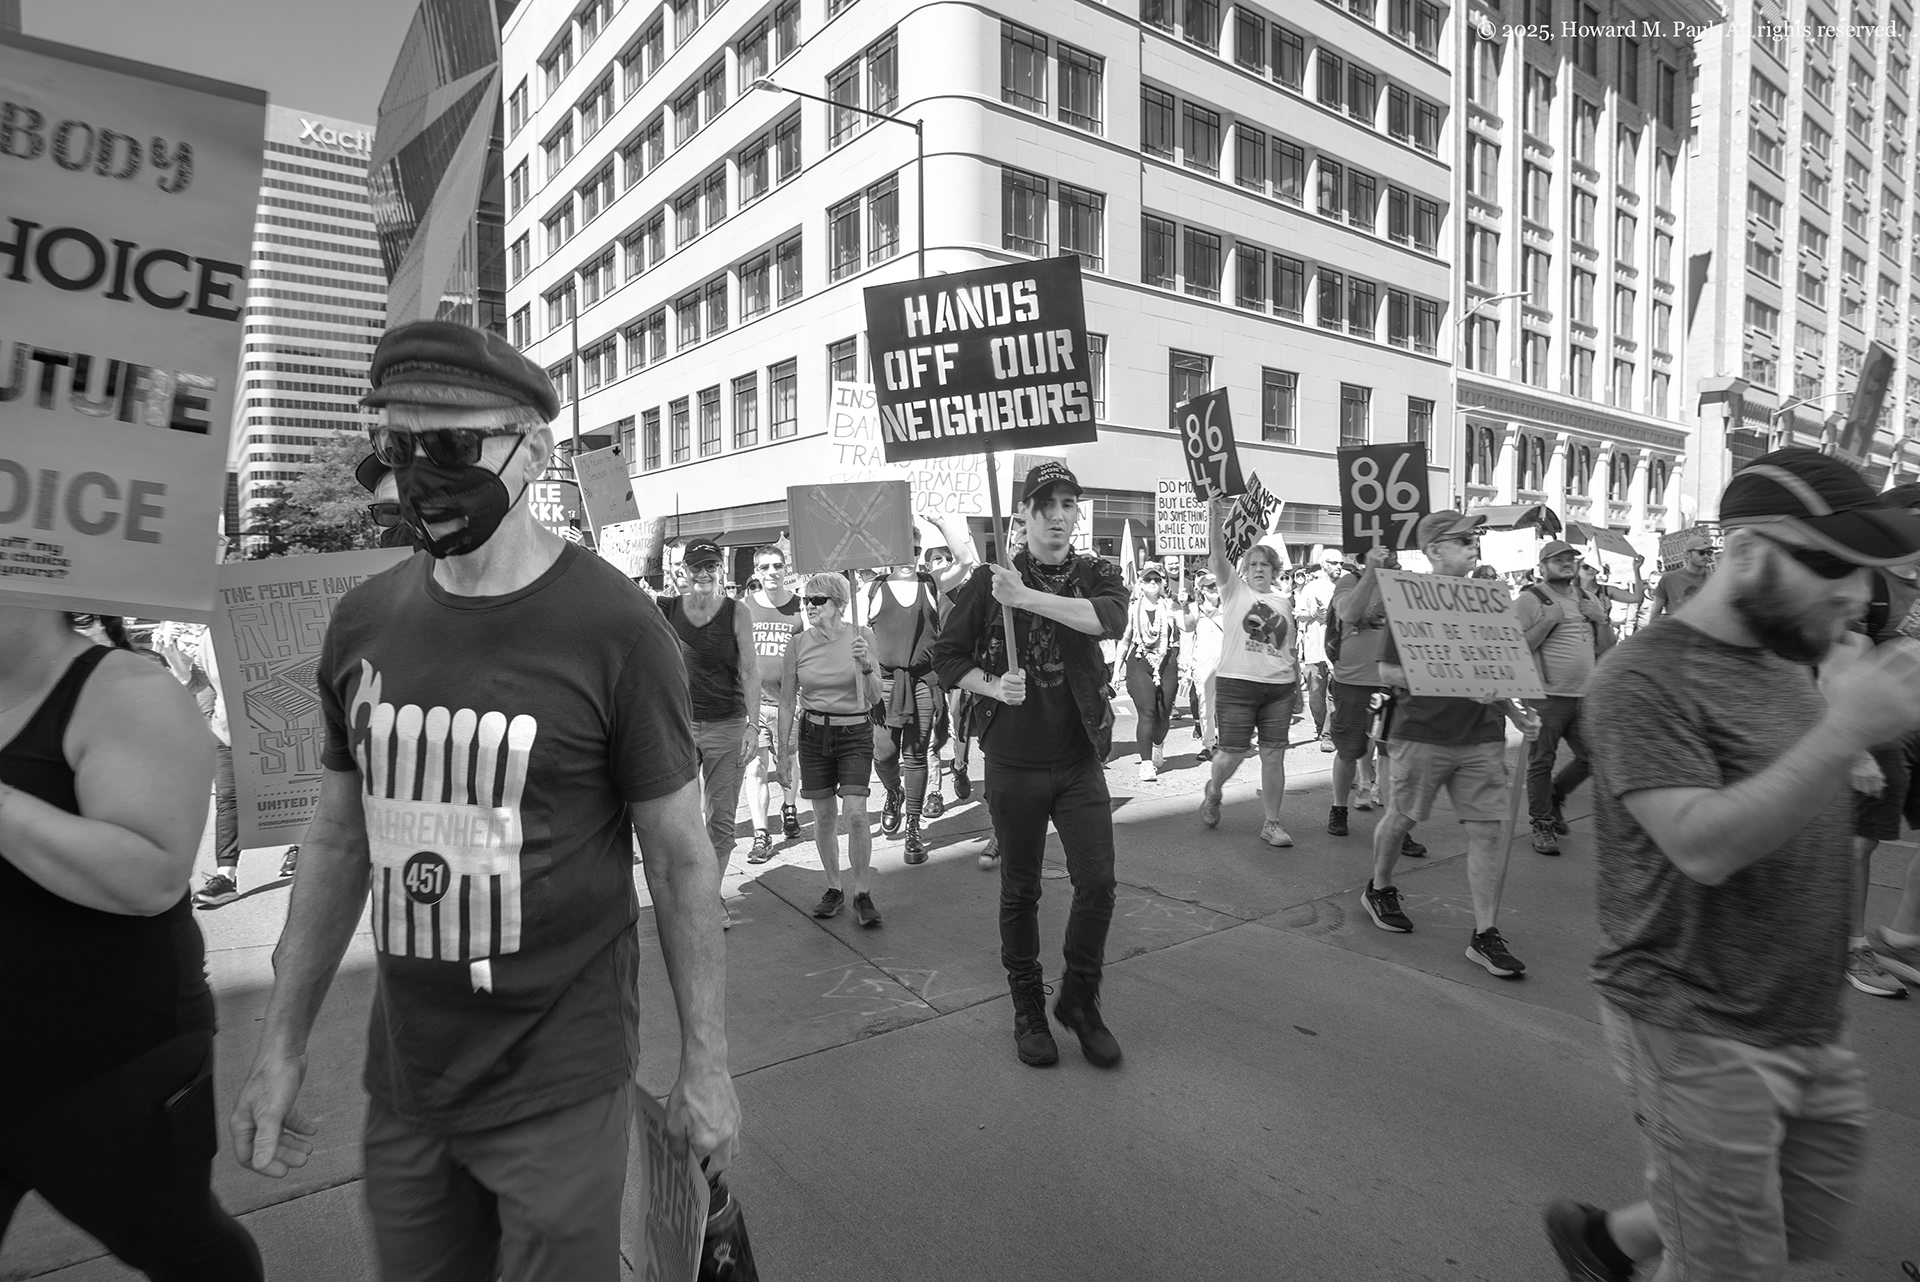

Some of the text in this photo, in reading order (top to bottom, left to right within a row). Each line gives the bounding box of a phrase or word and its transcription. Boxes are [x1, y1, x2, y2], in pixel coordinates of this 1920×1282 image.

[299, 118, 376, 153] Xactl
[904, 279, 1040, 338] HANDS
[883, 329, 1075, 391] OFF OUR
[836, 387, 876, 409] INS
[881, 381, 1092, 443] NEIGHBORS
[1185, 399, 1224, 459] 86
[907, 471, 981, 492] ARMED
[1037, 473, 1071, 482] MATTER
[1190, 451, 1228, 496] 47
[1350, 452, 1420, 512] 86
[529, 483, 561, 503] ICE
[1159, 481, 1194, 493] DO MO
[1159, 497, 1177, 509] BUY
[1260, 488, 1282, 513] NOT
[528, 502, 565, 523] KKK
[1158, 510, 1208, 522] DO SOMETHING
[1158, 523, 1206, 535] WHILE YOU
[1353, 512, 1420, 550] 47
[1159, 536, 1206, 550] STILL CAN
[219, 575, 362, 604] THE PEOPLE HAVE
[753, 631, 792, 643] TRANS
[1442, 623, 1464, 640] BE
[1459, 645, 1522, 662] BENEFIT
[1426, 662, 1517, 680] CUTS AHEAD
[370, 808, 511, 849] AHRENHEIT
[405, 862, 444, 895] 451
